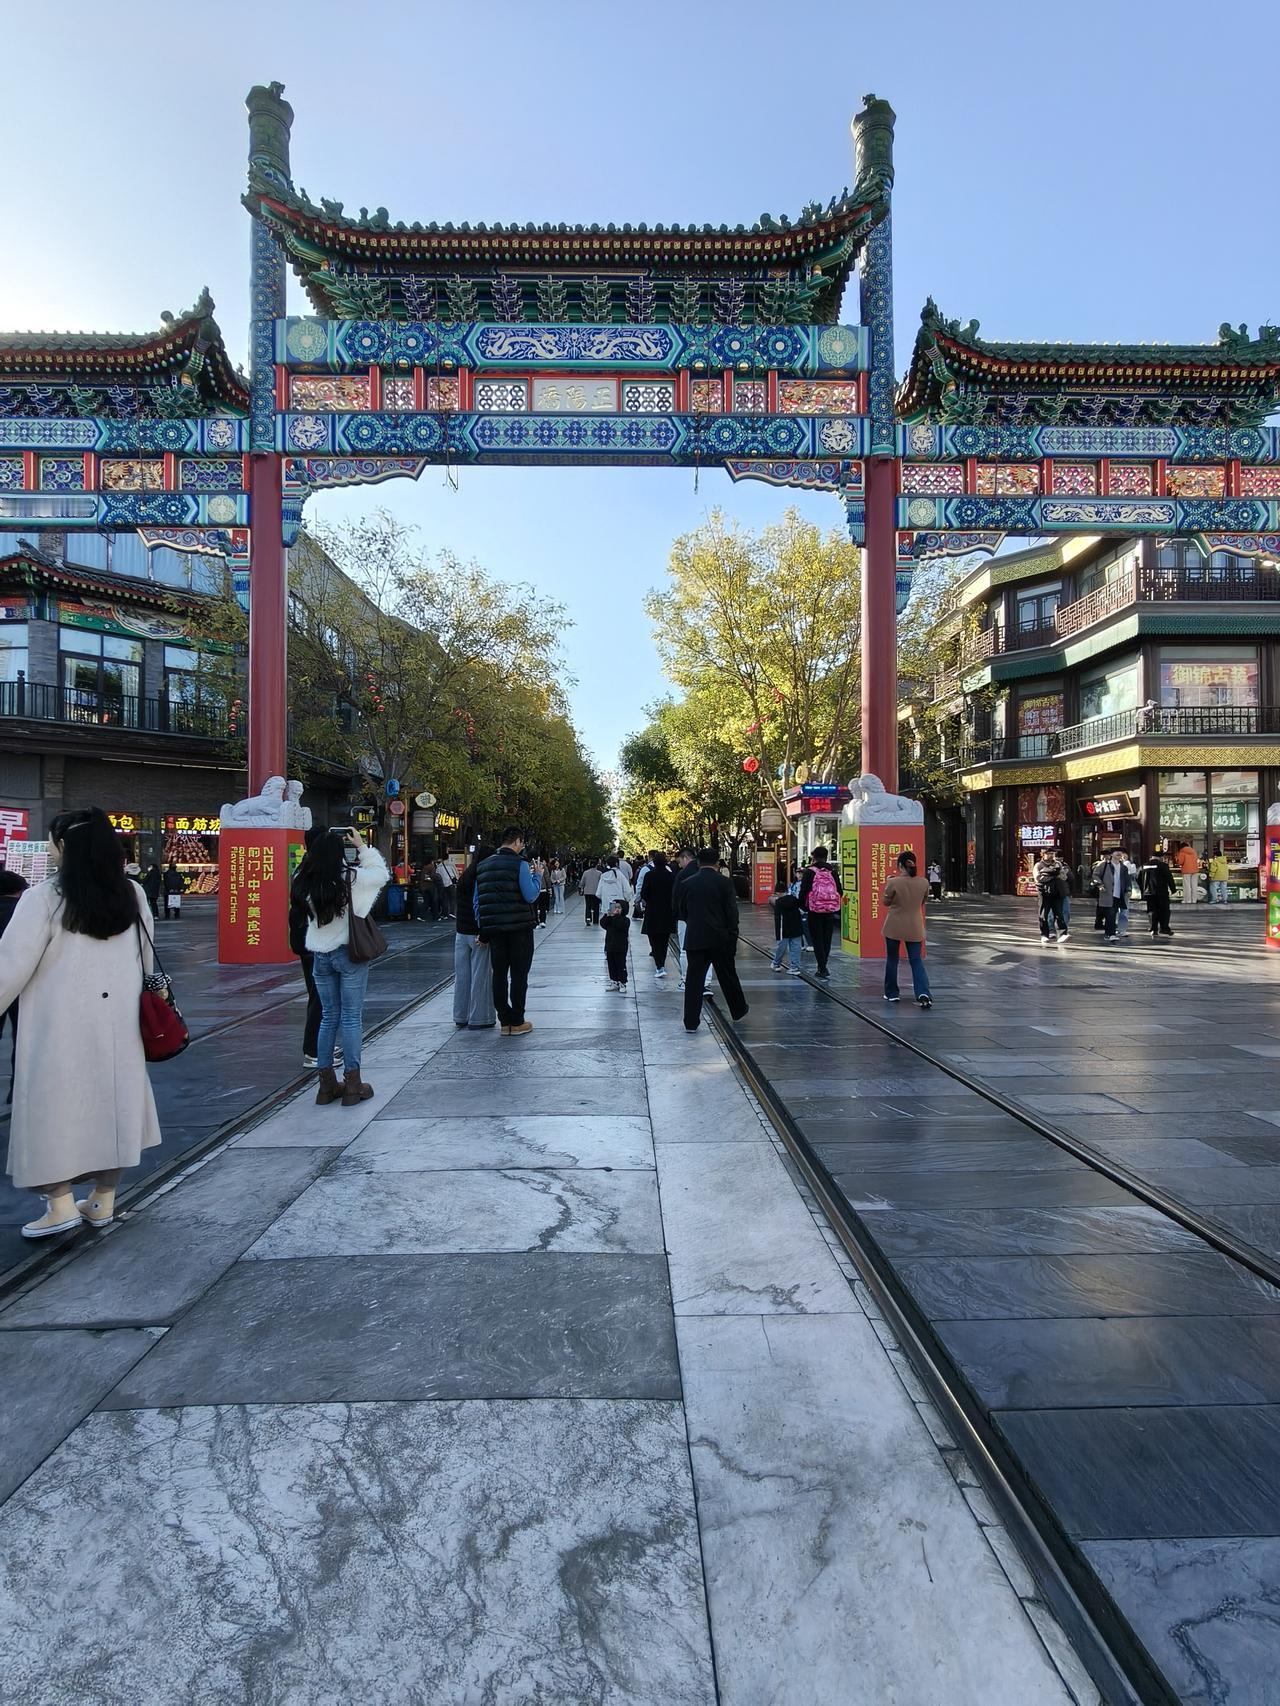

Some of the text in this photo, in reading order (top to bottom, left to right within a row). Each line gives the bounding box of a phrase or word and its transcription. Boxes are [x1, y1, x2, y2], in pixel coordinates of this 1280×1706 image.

[537, 385, 613, 409] 正陽橋
[1021, 825, 1055, 840] 糖葫芦
[263, 846, 274, 881] 2025
[230, 884, 237, 895] of
[872, 879, 879, 891] of
